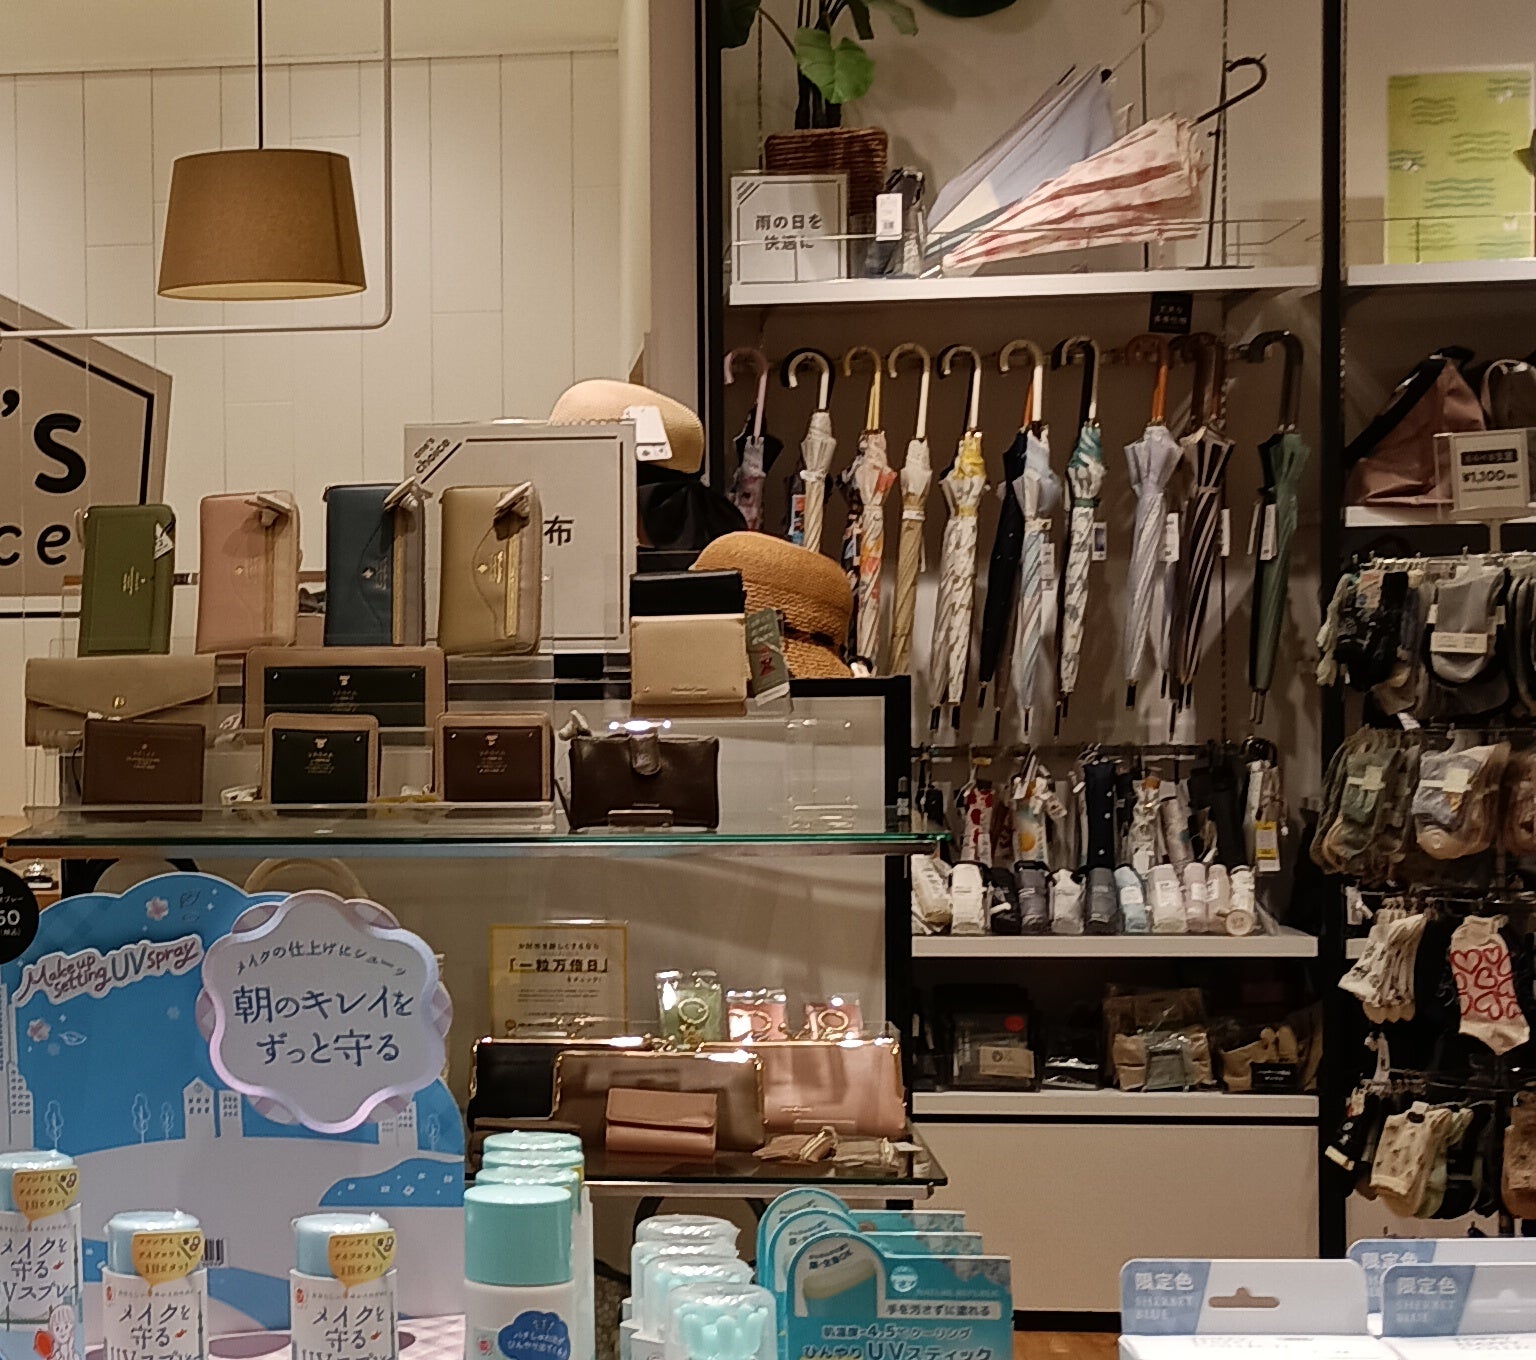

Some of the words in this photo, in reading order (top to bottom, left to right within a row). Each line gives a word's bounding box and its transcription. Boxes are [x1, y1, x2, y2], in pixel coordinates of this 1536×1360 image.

[755, 214, 823, 231] 雨の日を
[111, 946, 147, 982] UV
[147, 940, 200, 969] spray
[18, 955, 96, 1001] Makeup
[233, 984, 415, 1024] 朝のキレイを
[256, 1028, 401, 1066] ずっと守る
[11, 1259, 49, 1282] 守る
[1134, 1271, 1194, 1292] 限定色
[1397, 1276, 1458, 1297] 限定色
[130, 1327, 170, 1349] 守る
[325, 1330, 367, 1351] 守る
